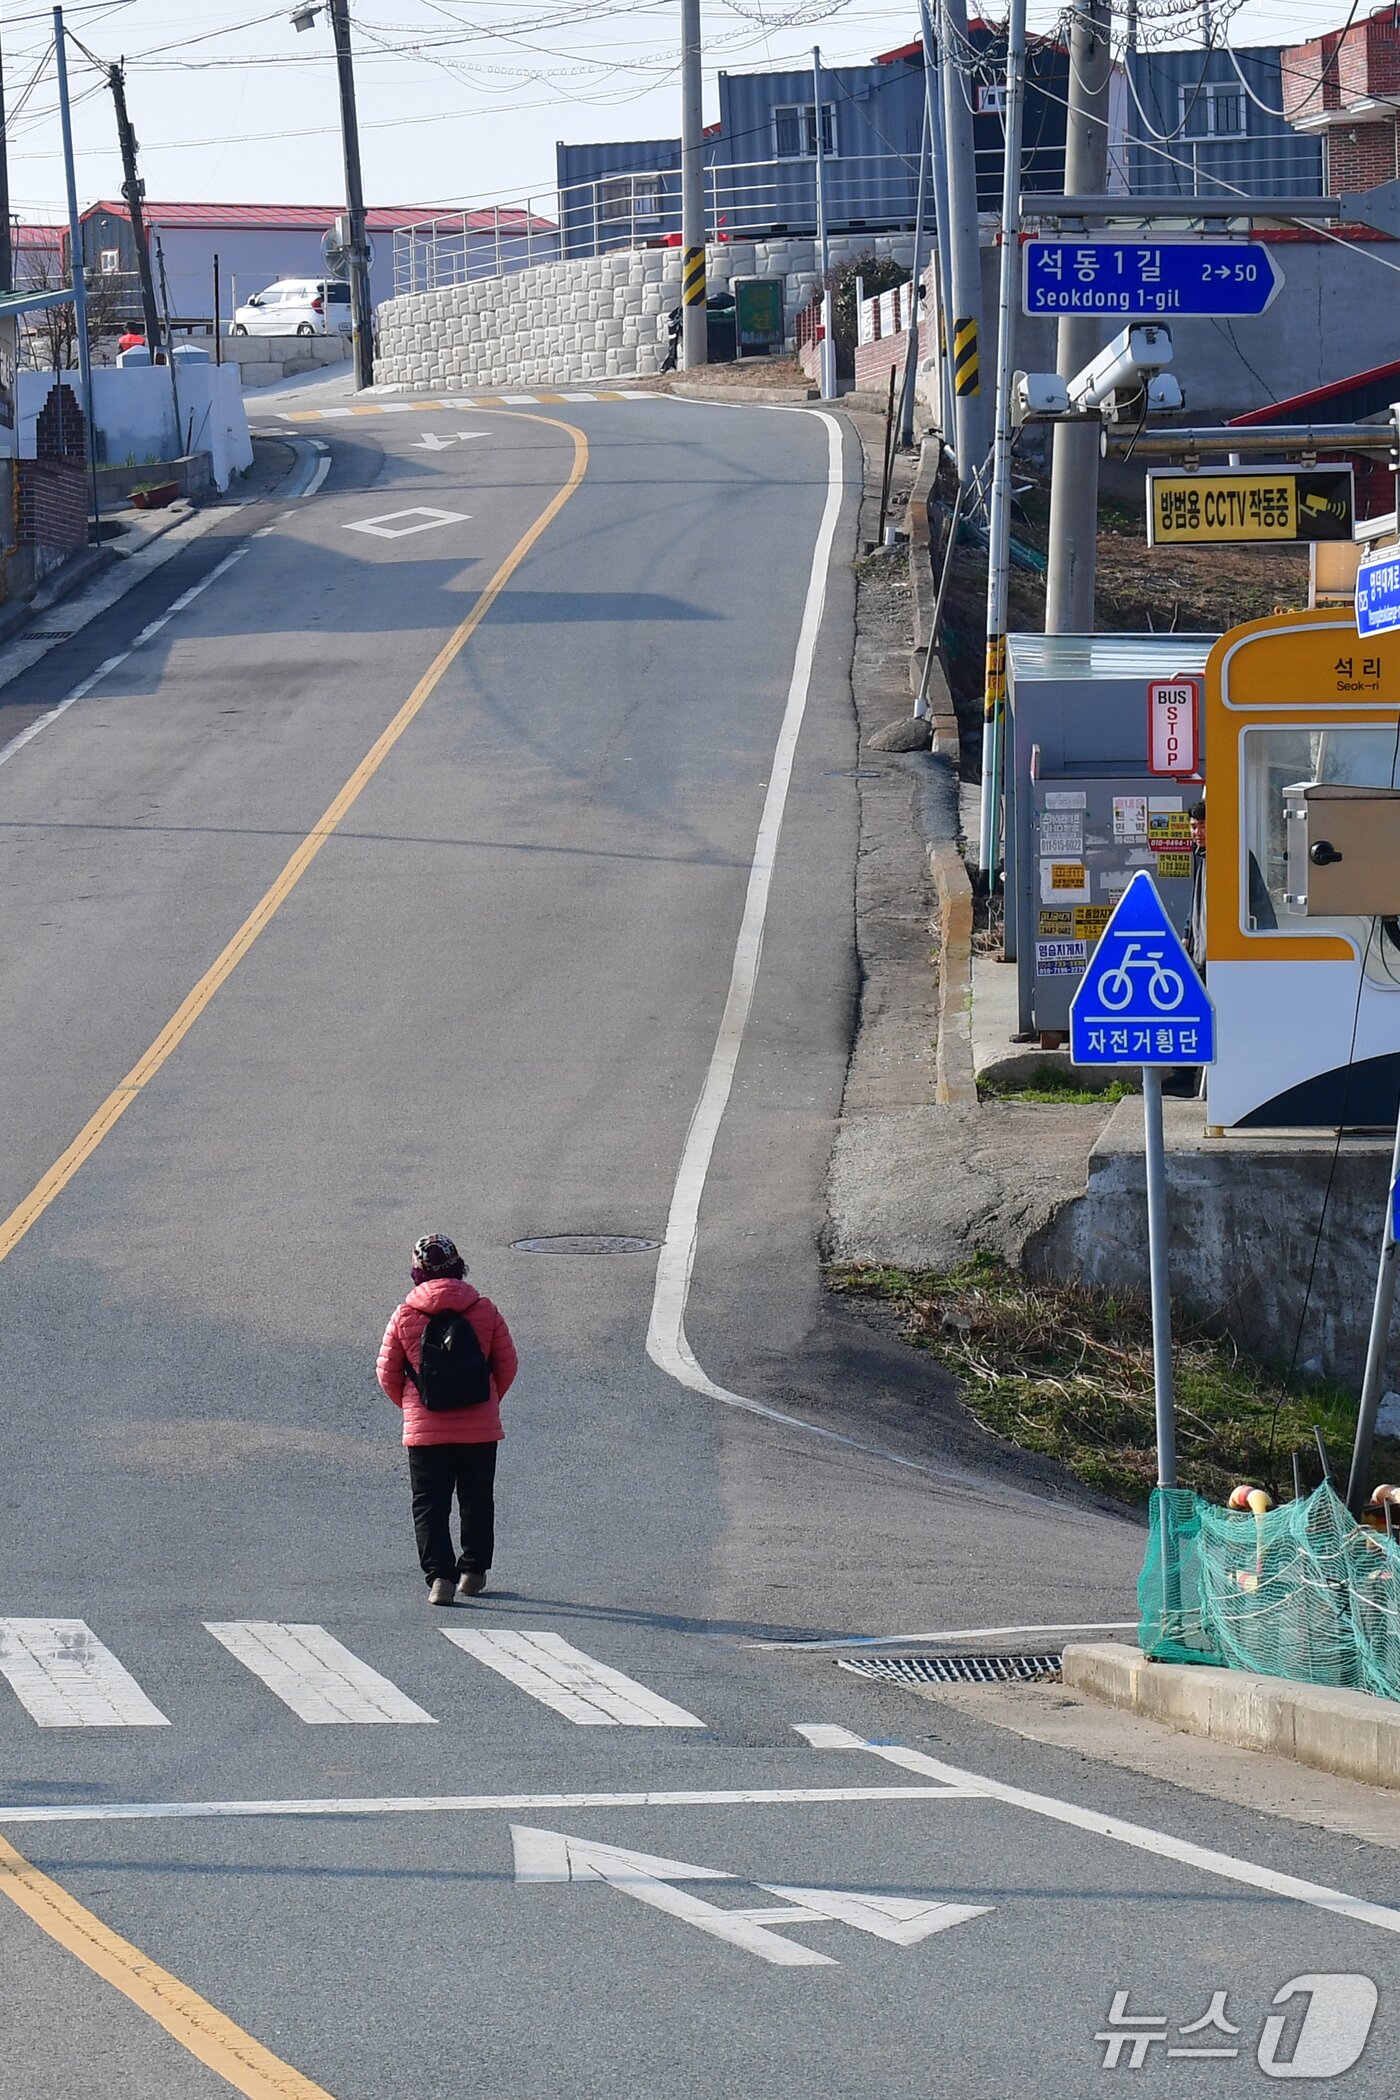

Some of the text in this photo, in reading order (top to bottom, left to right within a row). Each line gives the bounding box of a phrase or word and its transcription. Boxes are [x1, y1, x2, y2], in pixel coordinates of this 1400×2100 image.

[1036, 288, 1180, 310] Seokdong 1-gil
[1161, 488, 1289, 530] 방범용 CCTV 작동중
[1158, 690, 1187, 704] BUS
[1336, 681, 1379, 691] Seok-ri
[1166, 706, 1178, 766] STOP
[1087, 1028, 1198, 1054] 자전거횡단
